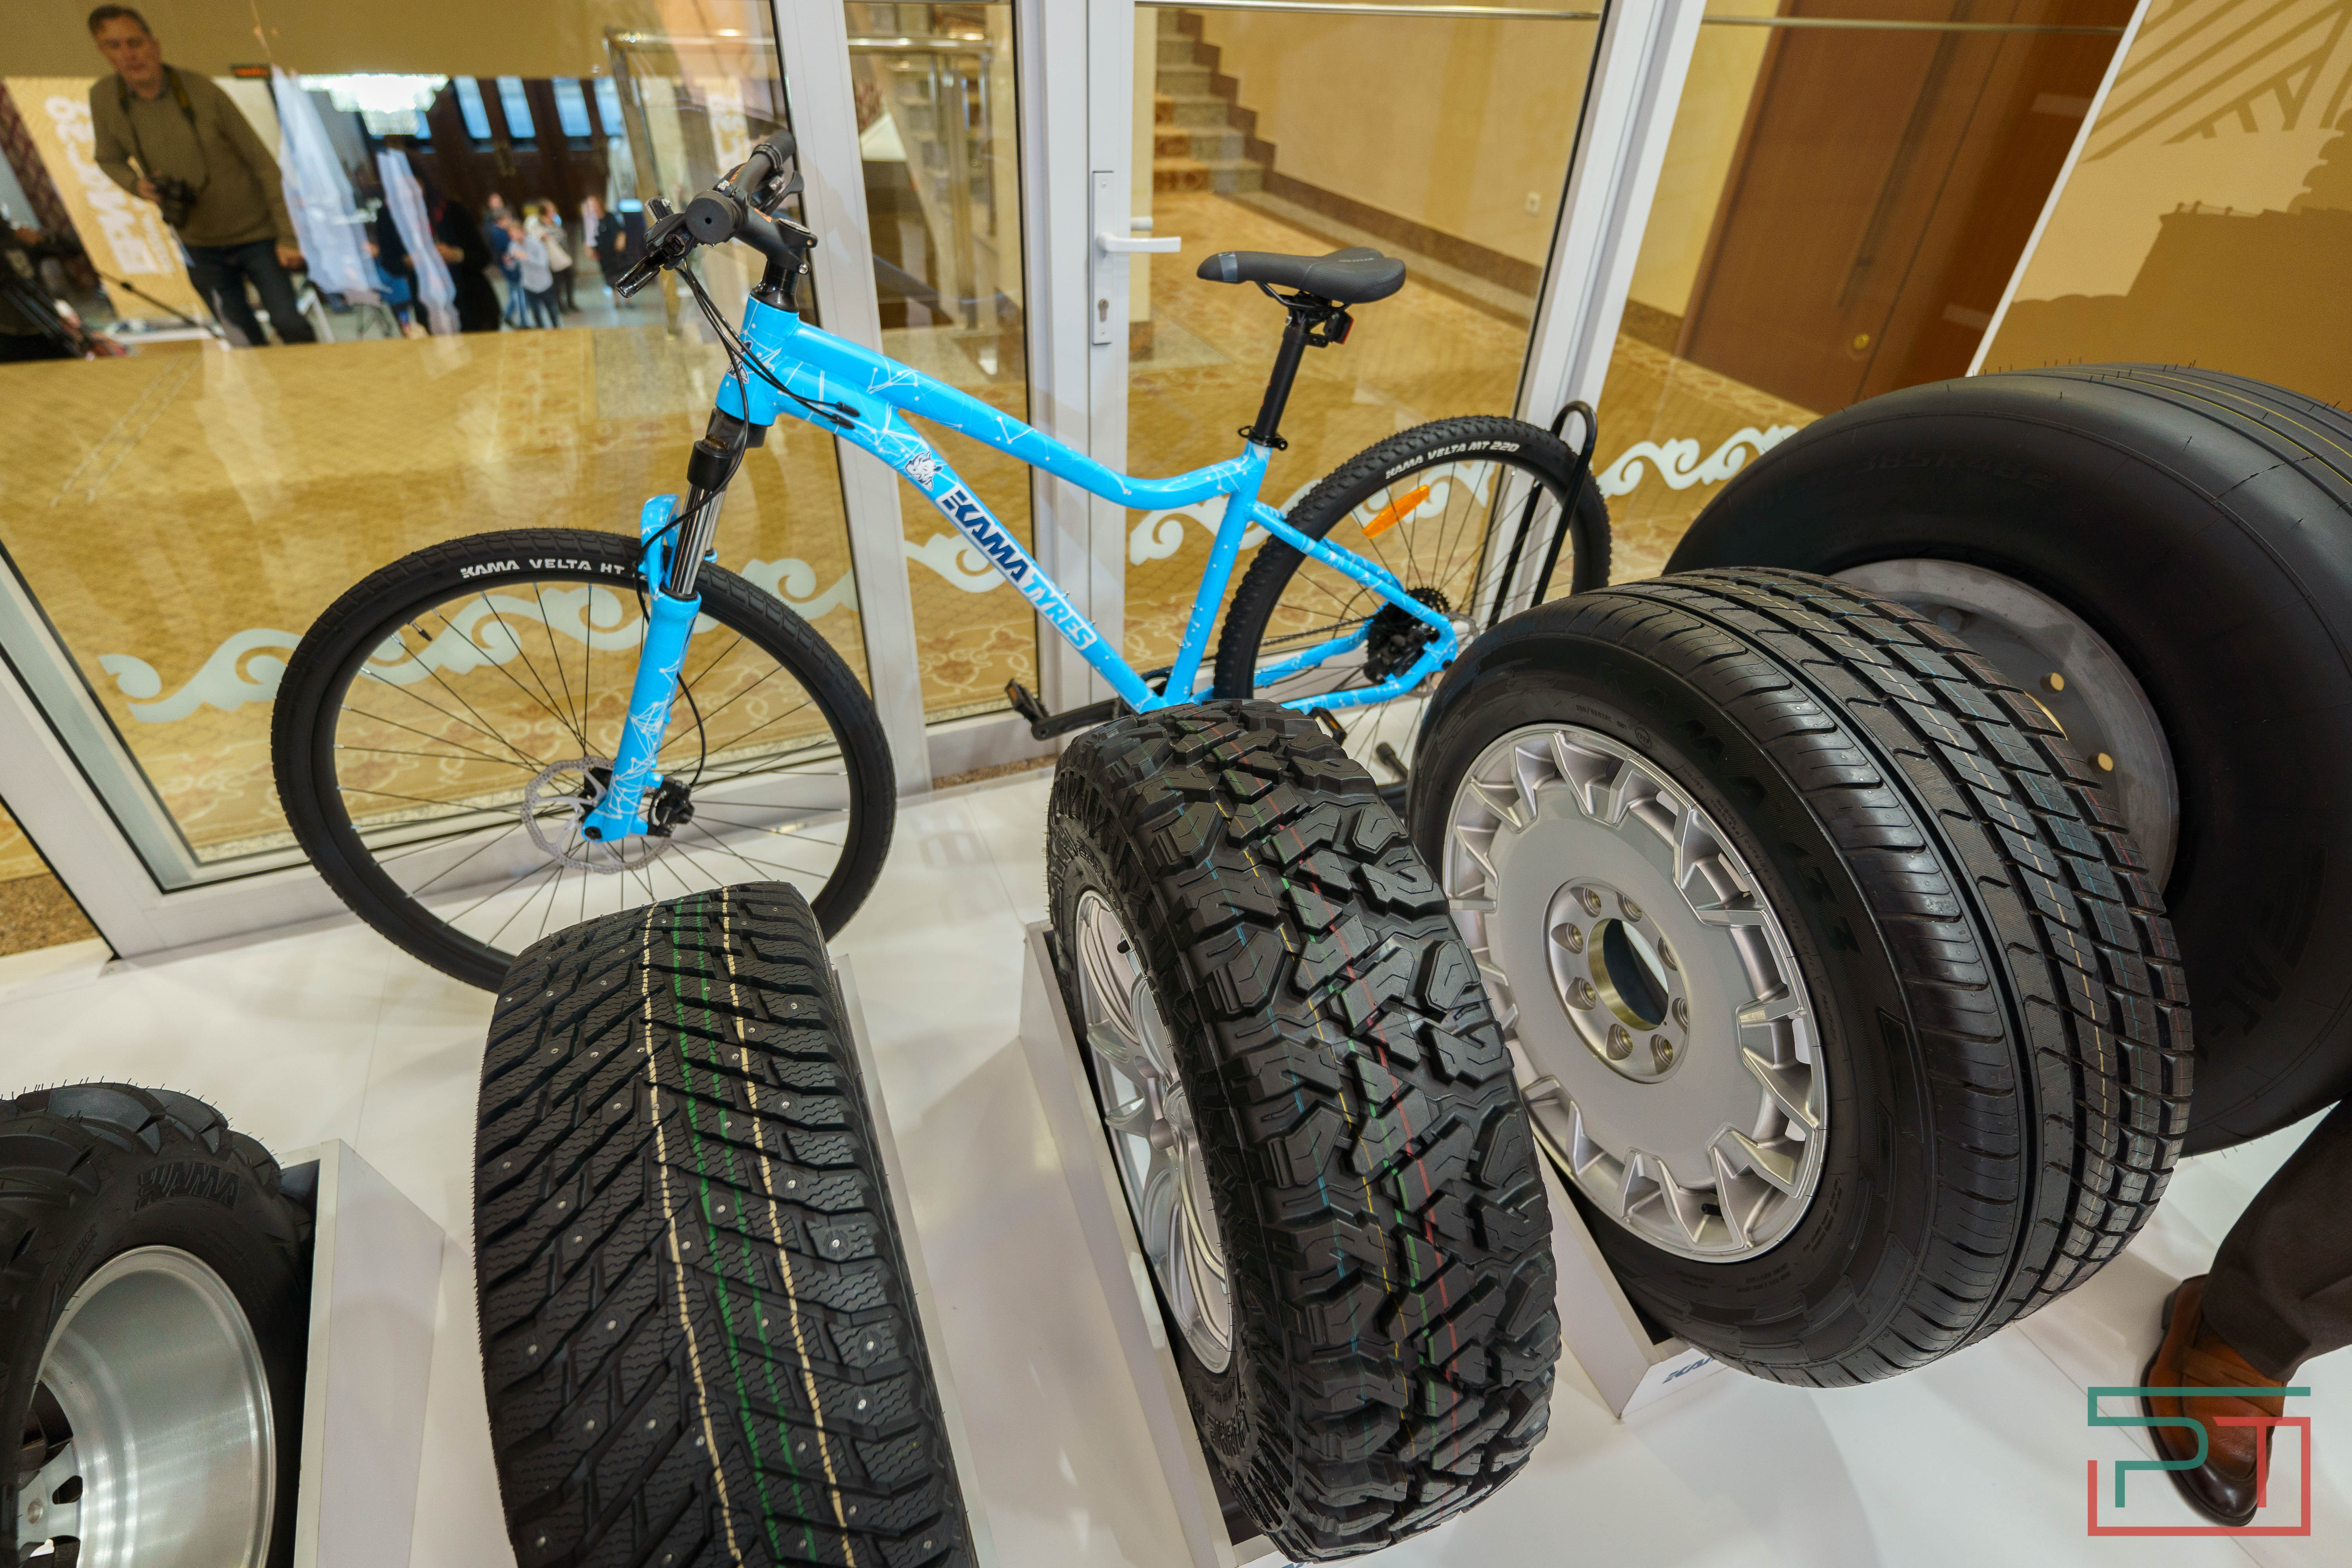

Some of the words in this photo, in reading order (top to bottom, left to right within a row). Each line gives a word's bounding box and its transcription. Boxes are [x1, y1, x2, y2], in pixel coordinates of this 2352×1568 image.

[1386, 455, 1424, 479] KAMA
[1427, 441, 1466, 460] VELTA
[1468, 441, 1491, 451] MT
[1489, 441, 1520, 452] 220
[460, 559, 520, 579] KAMA
[529, 558, 592, 571] VELTA
[600, 562, 625, 574] HT
[941, 489, 1030, 583] KAMA
[1023, 572, 1094, 648] TYRES
[134, 1160, 239, 1212] KAMA
